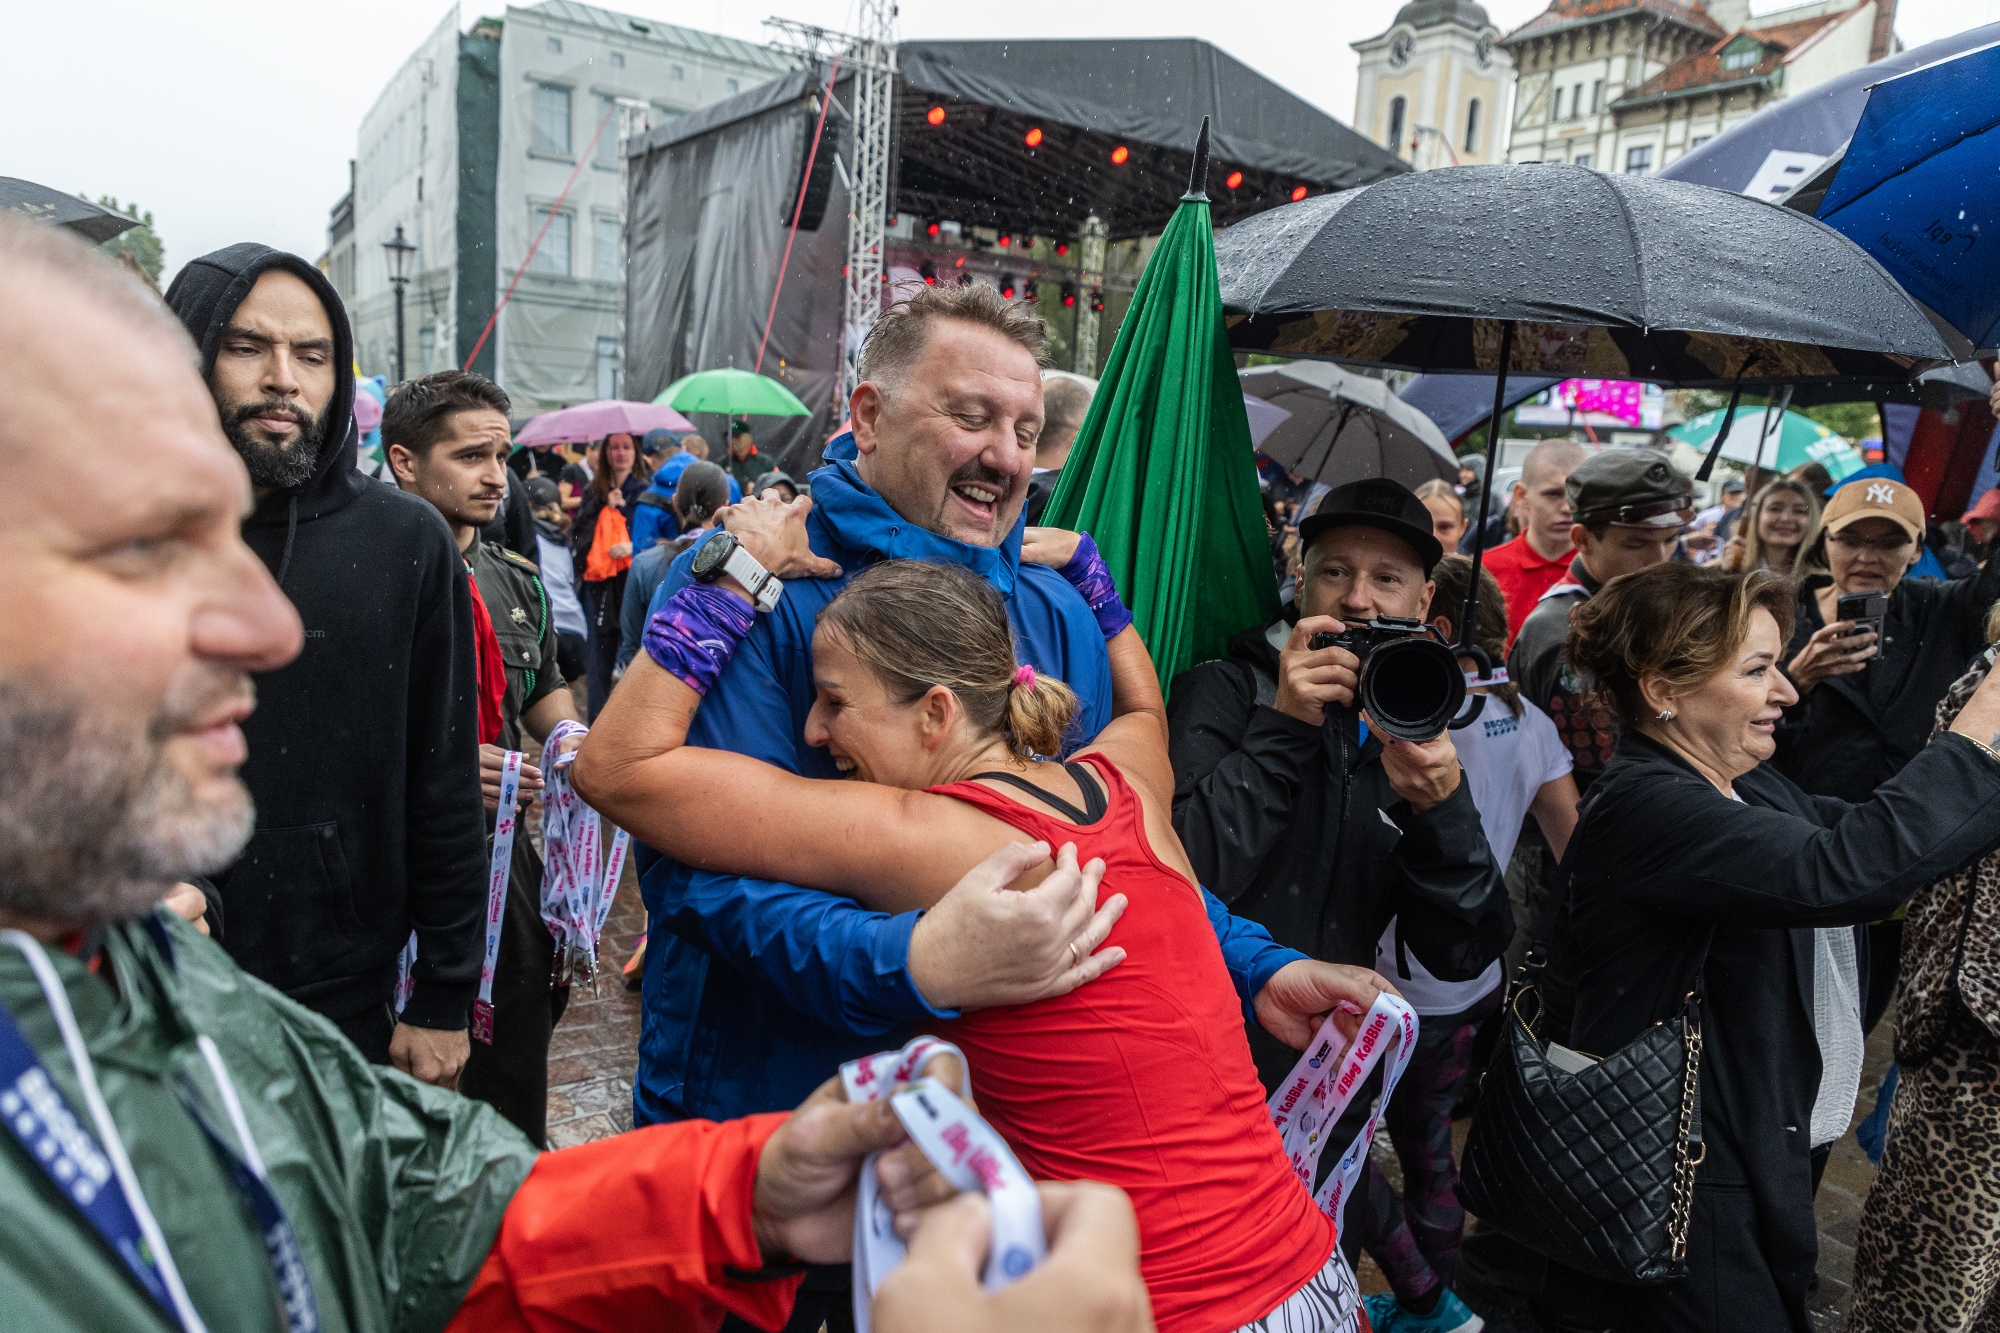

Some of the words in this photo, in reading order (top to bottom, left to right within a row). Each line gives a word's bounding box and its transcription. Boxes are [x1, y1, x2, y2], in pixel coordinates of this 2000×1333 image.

[1866, 483, 1895, 505] NY
[1341, 1062, 1362, 1089] Bieg
[1355, 1012, 1388, 1062] KoBBiet
[1278, 1077, 1309, 1114] KoBBiet
